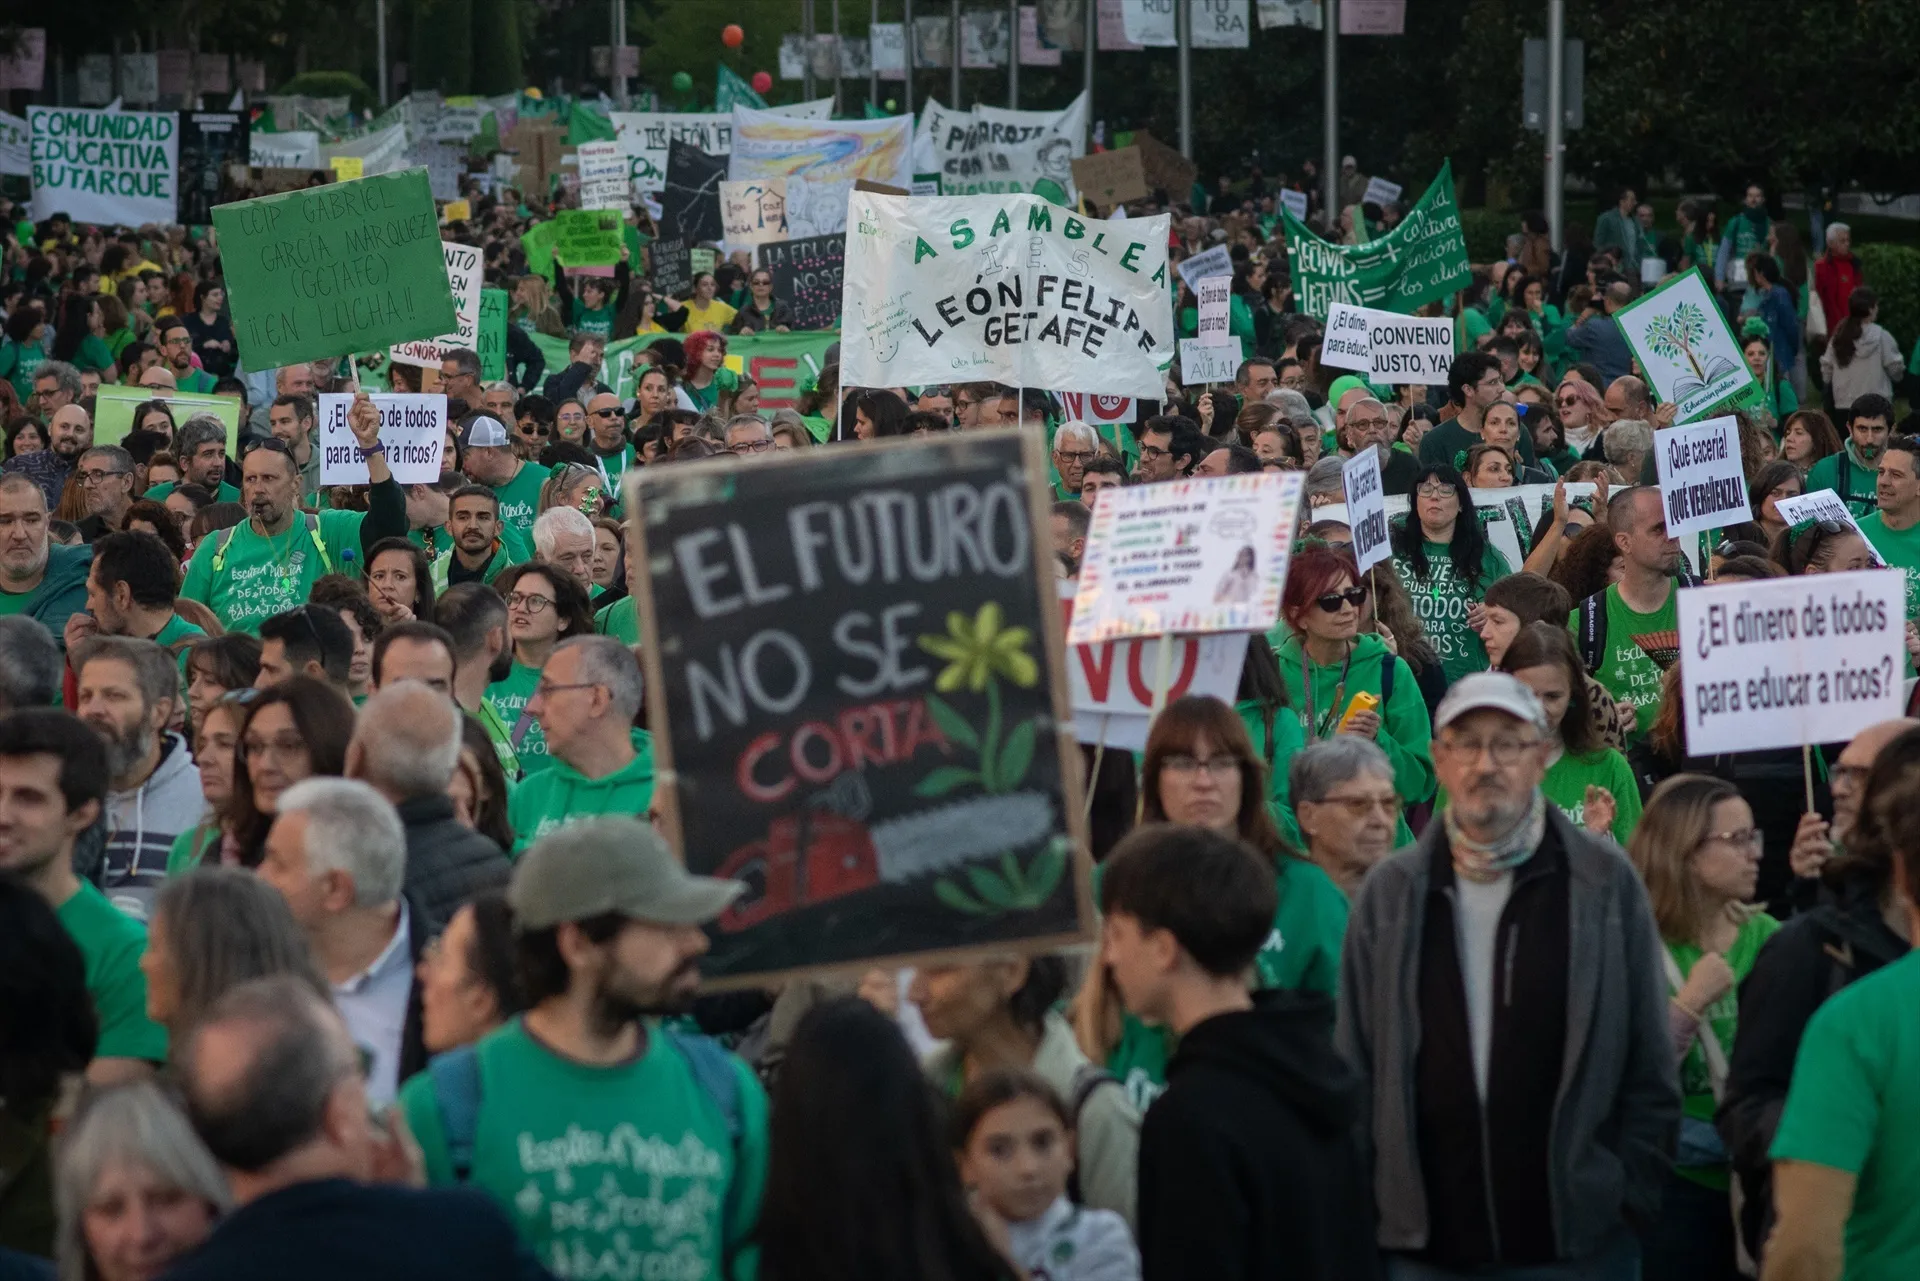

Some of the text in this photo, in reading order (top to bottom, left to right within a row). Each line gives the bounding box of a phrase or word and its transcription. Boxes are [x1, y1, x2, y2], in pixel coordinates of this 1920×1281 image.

[1215, 15, 1245, 33] RA
[31, 111, 173, 141] COMUNIDAD
[30, 138, 169, 169] EDUCATIVA
[32, 164, 170, 198] BUTARQUE
[240, 185, 395, 236] CEIP GABRIEL
[261, 212, 431, 272] GARCÍA MÁRQUEZ
[766, 240, 845, 265] LA EDUCA
[914, 203, 1167, 289] ASAMBLEA
[291, 253, 389, 299] (GETAFE)
[793, 273, 819, 294] NO
[317, 287, 415, 337] LUCHA!!
[911, 274, 1023, 348] LEÓN
[1036, 274, 1157, 353] FELIPE
[1333, 311, 1348, 331] ¿El
[984, 312, 1107, 359] GETAFE
[1327, 338, 1344, 355] para
[1369, 327, 1450, 350] ¡CONVENIO
[1191, 361, 1233, 380] AULA!
[1372, 354, 1425, 376] JUSTO,
[328, 403, 437, 434] ¿El de todos
[326, 445, 350, 470] para
[393, 446, 401, 464] a
[403, 441, 438, 464] ricos?
[1668, 428, 1728, 478] ¡Qué cacería!
[1668, 475, 1745, 526] ¡QUÉ VERGÜENZA!
[673, 482, 1031, 618] EL FUTURO
[237, 588, 251, 599] DE
[1697, 589, 1887, 660] ¿El dinero de todos
[685, 603, 929, 741] NO SE
[1696, 654, 1894, 726] para educar a ricos?
[736, 699, 951, 800] CORTA
